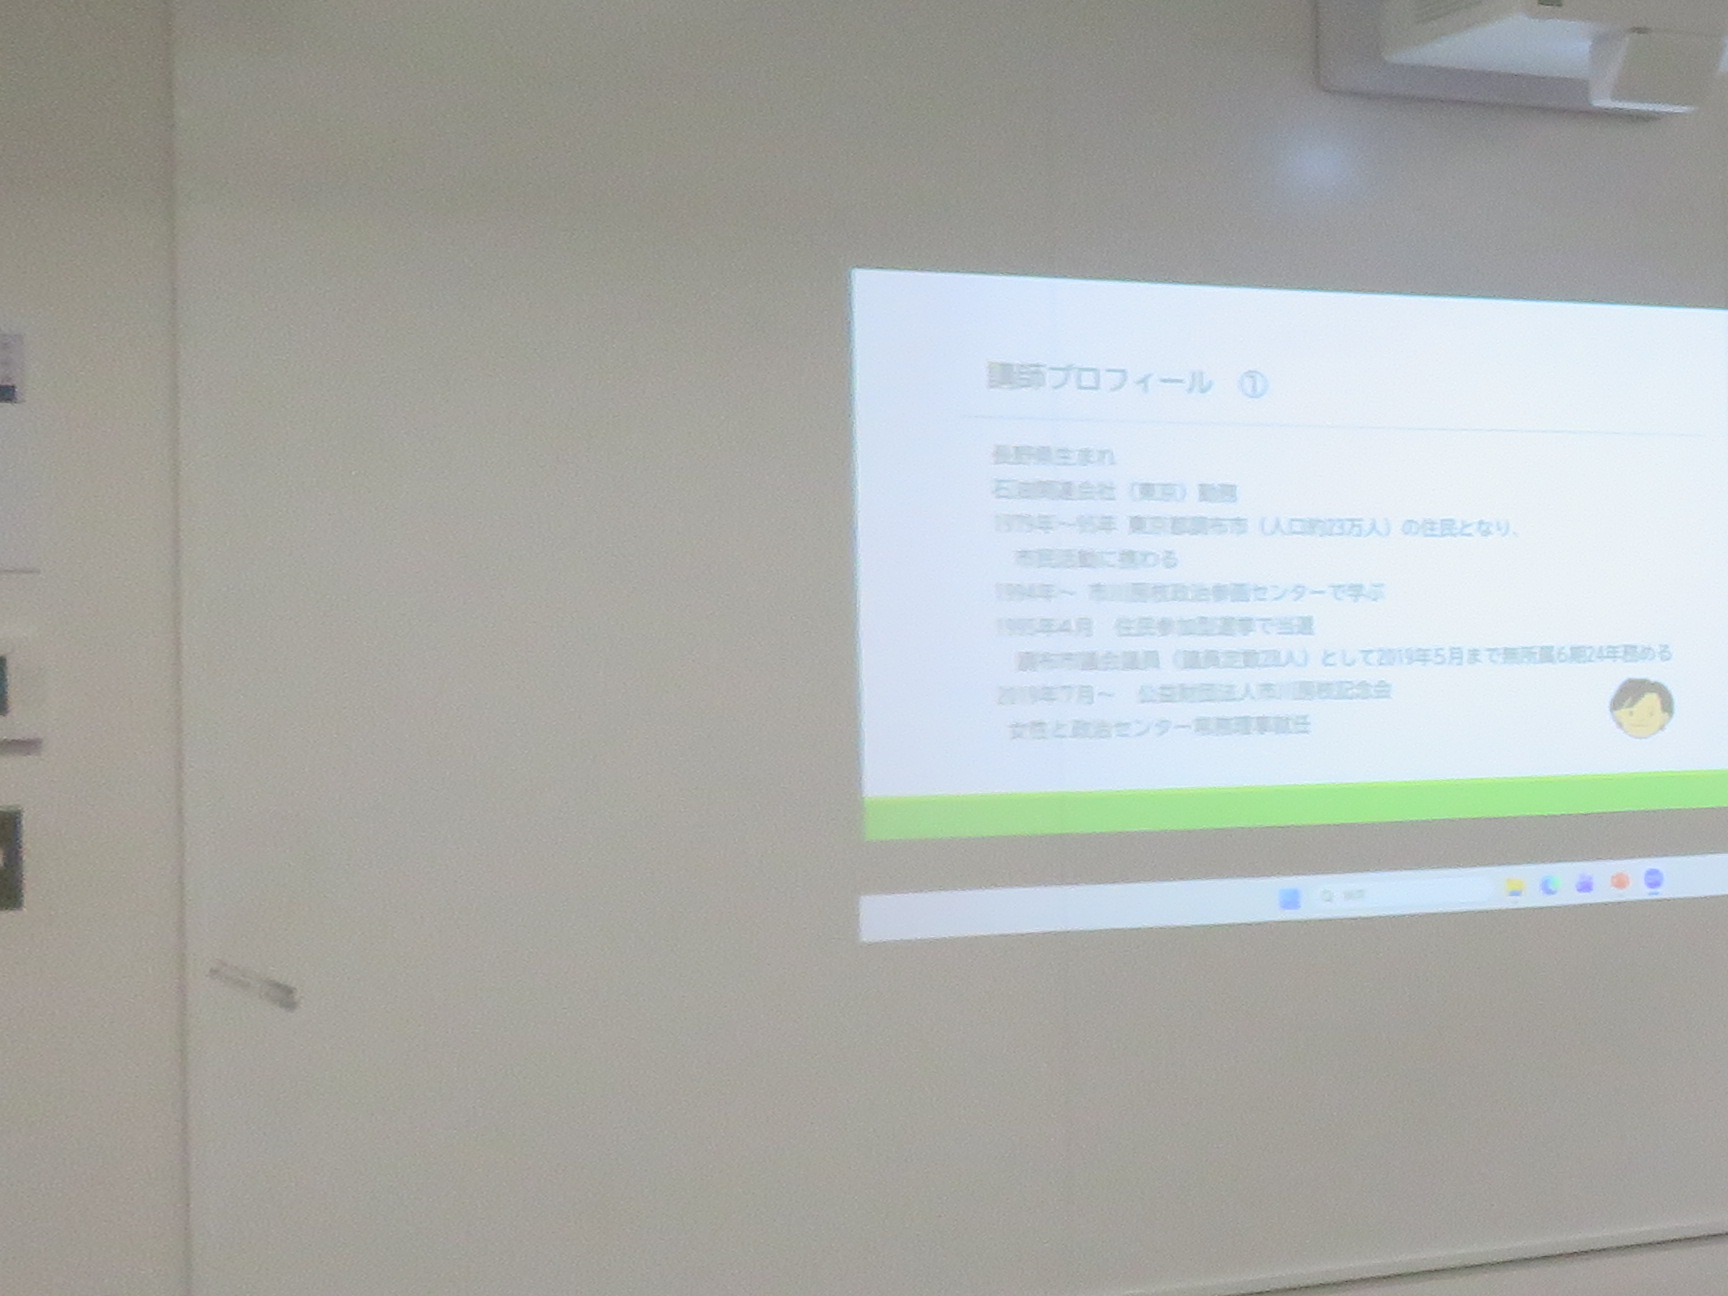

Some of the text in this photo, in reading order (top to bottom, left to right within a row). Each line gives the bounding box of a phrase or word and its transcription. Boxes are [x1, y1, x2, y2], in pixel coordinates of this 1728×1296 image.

[987, 361, 1213, 395] 講師プロフィール
